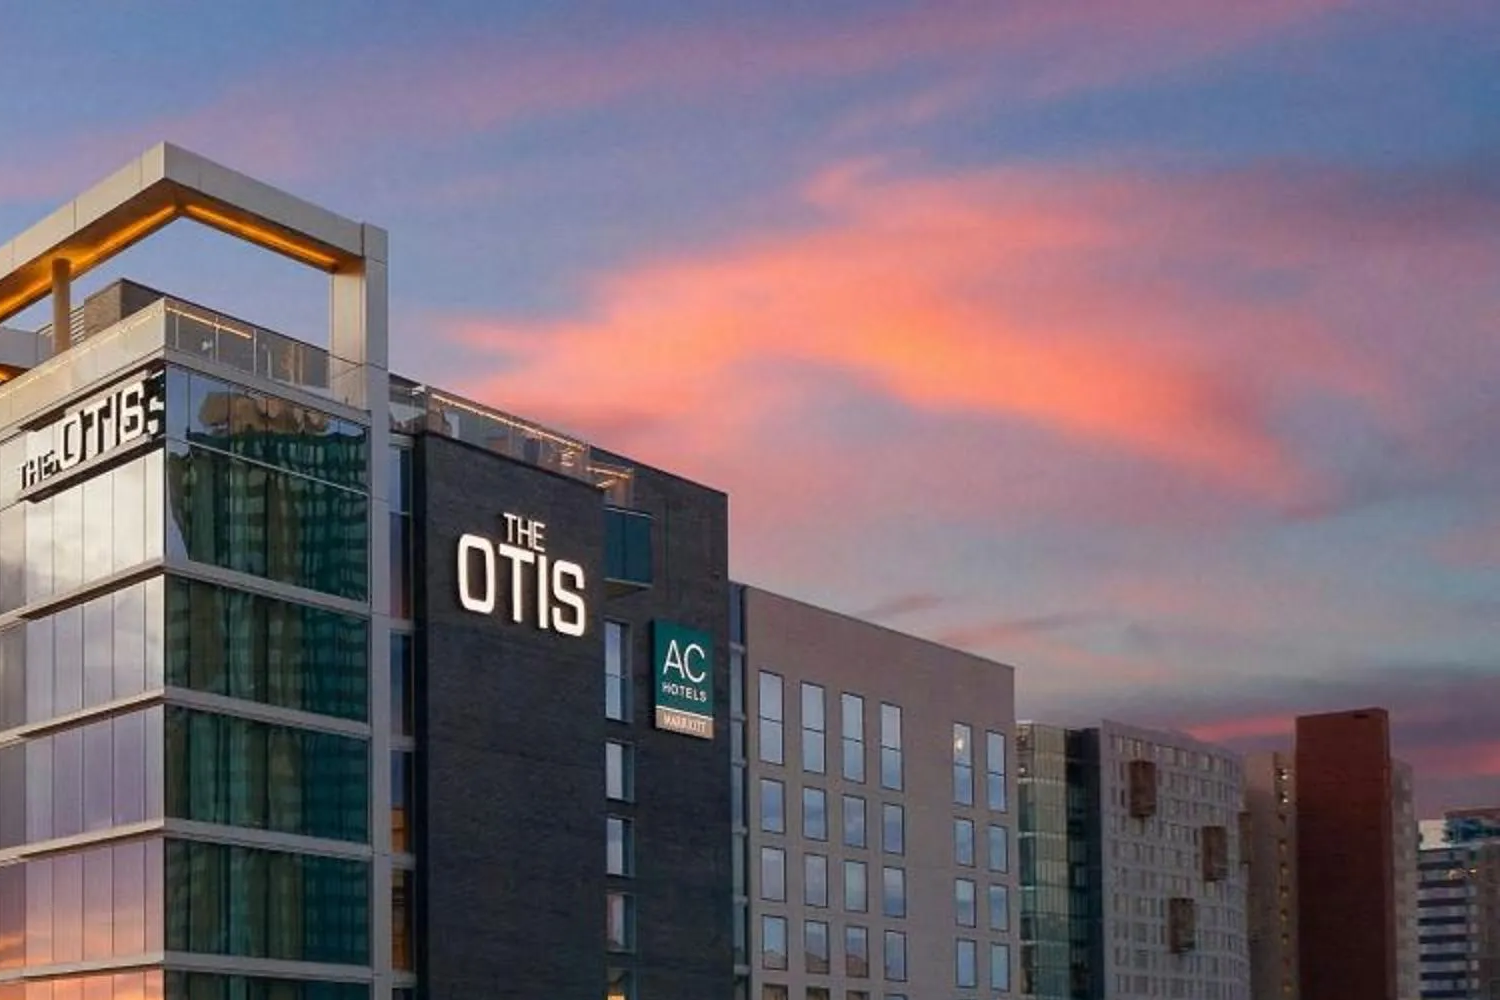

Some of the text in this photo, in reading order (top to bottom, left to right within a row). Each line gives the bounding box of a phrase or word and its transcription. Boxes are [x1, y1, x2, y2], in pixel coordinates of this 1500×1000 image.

[503, 512, 546, 552] THE
[457, 533, 586, 637] OTIS
[662, 639, 706, 683] AC
[662, 681, 708, 703] HOTELS
